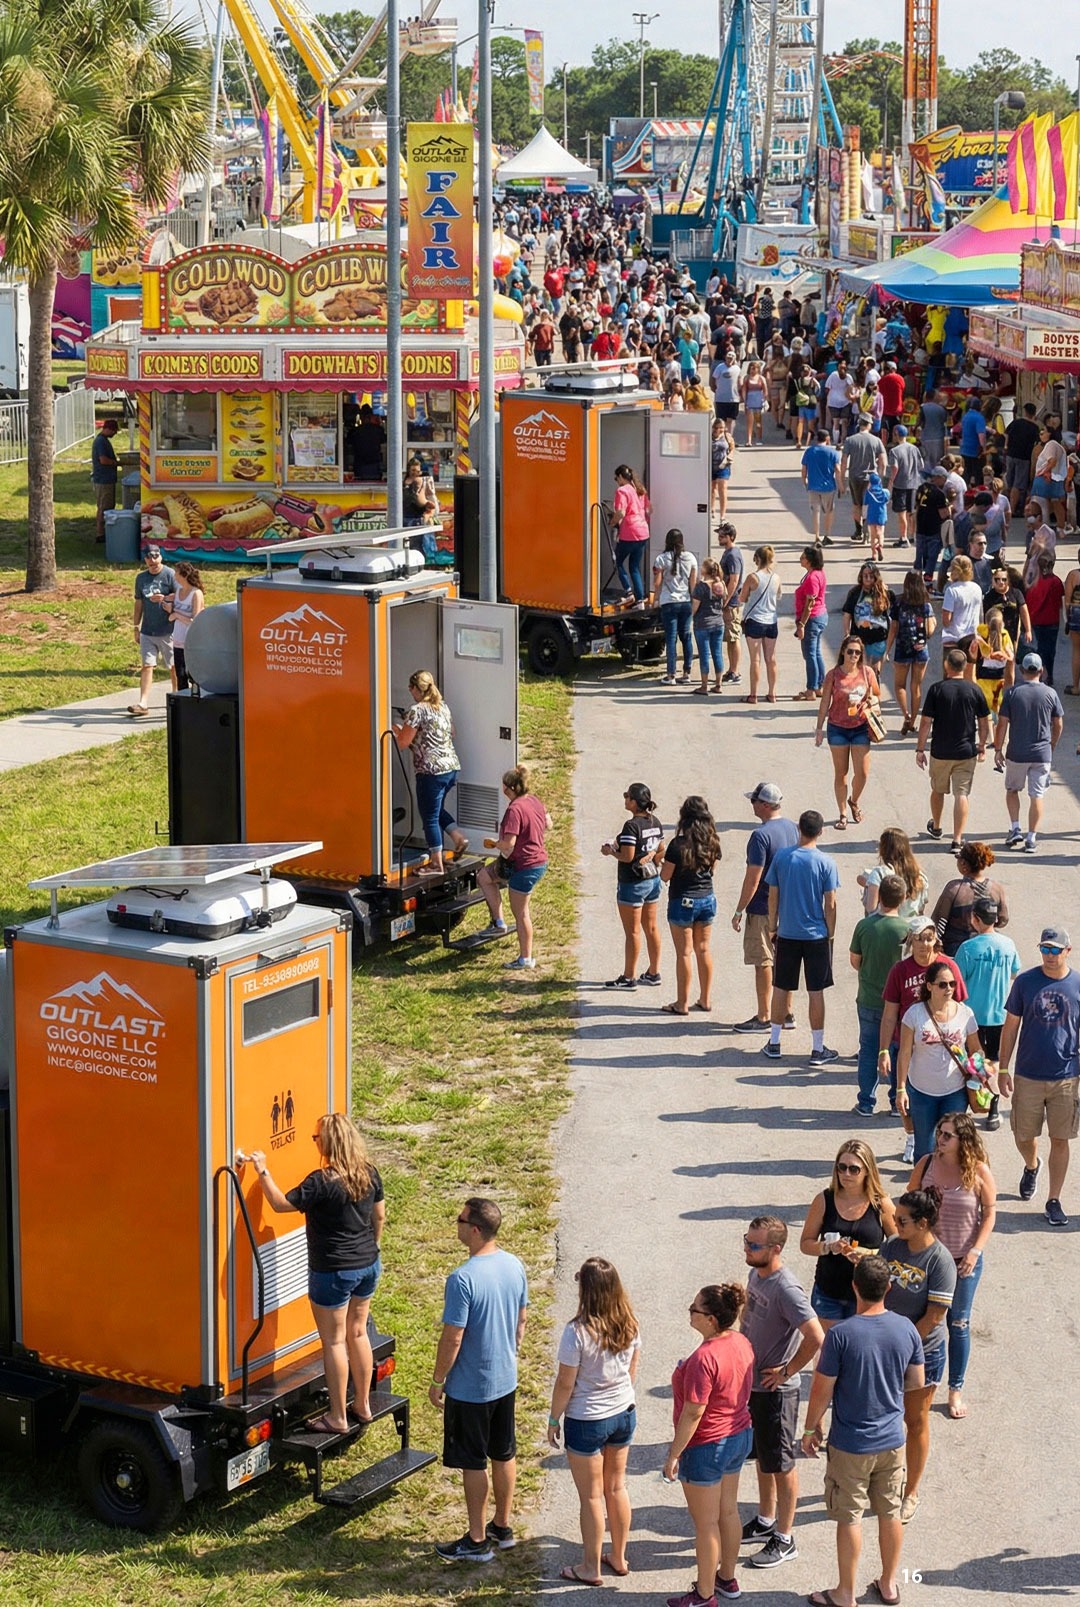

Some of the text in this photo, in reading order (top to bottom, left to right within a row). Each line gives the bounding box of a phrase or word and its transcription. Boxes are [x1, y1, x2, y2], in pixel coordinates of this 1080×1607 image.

[412, 147, 469, 156] OUTLAST
[420, 170, 462, 269] FAIR
[1043, 333, 1080, 345] BODYS
[264, 642, 343, 657] GIGONE LLC
[46, 1025, 158, 1055] GIGONE LLC
